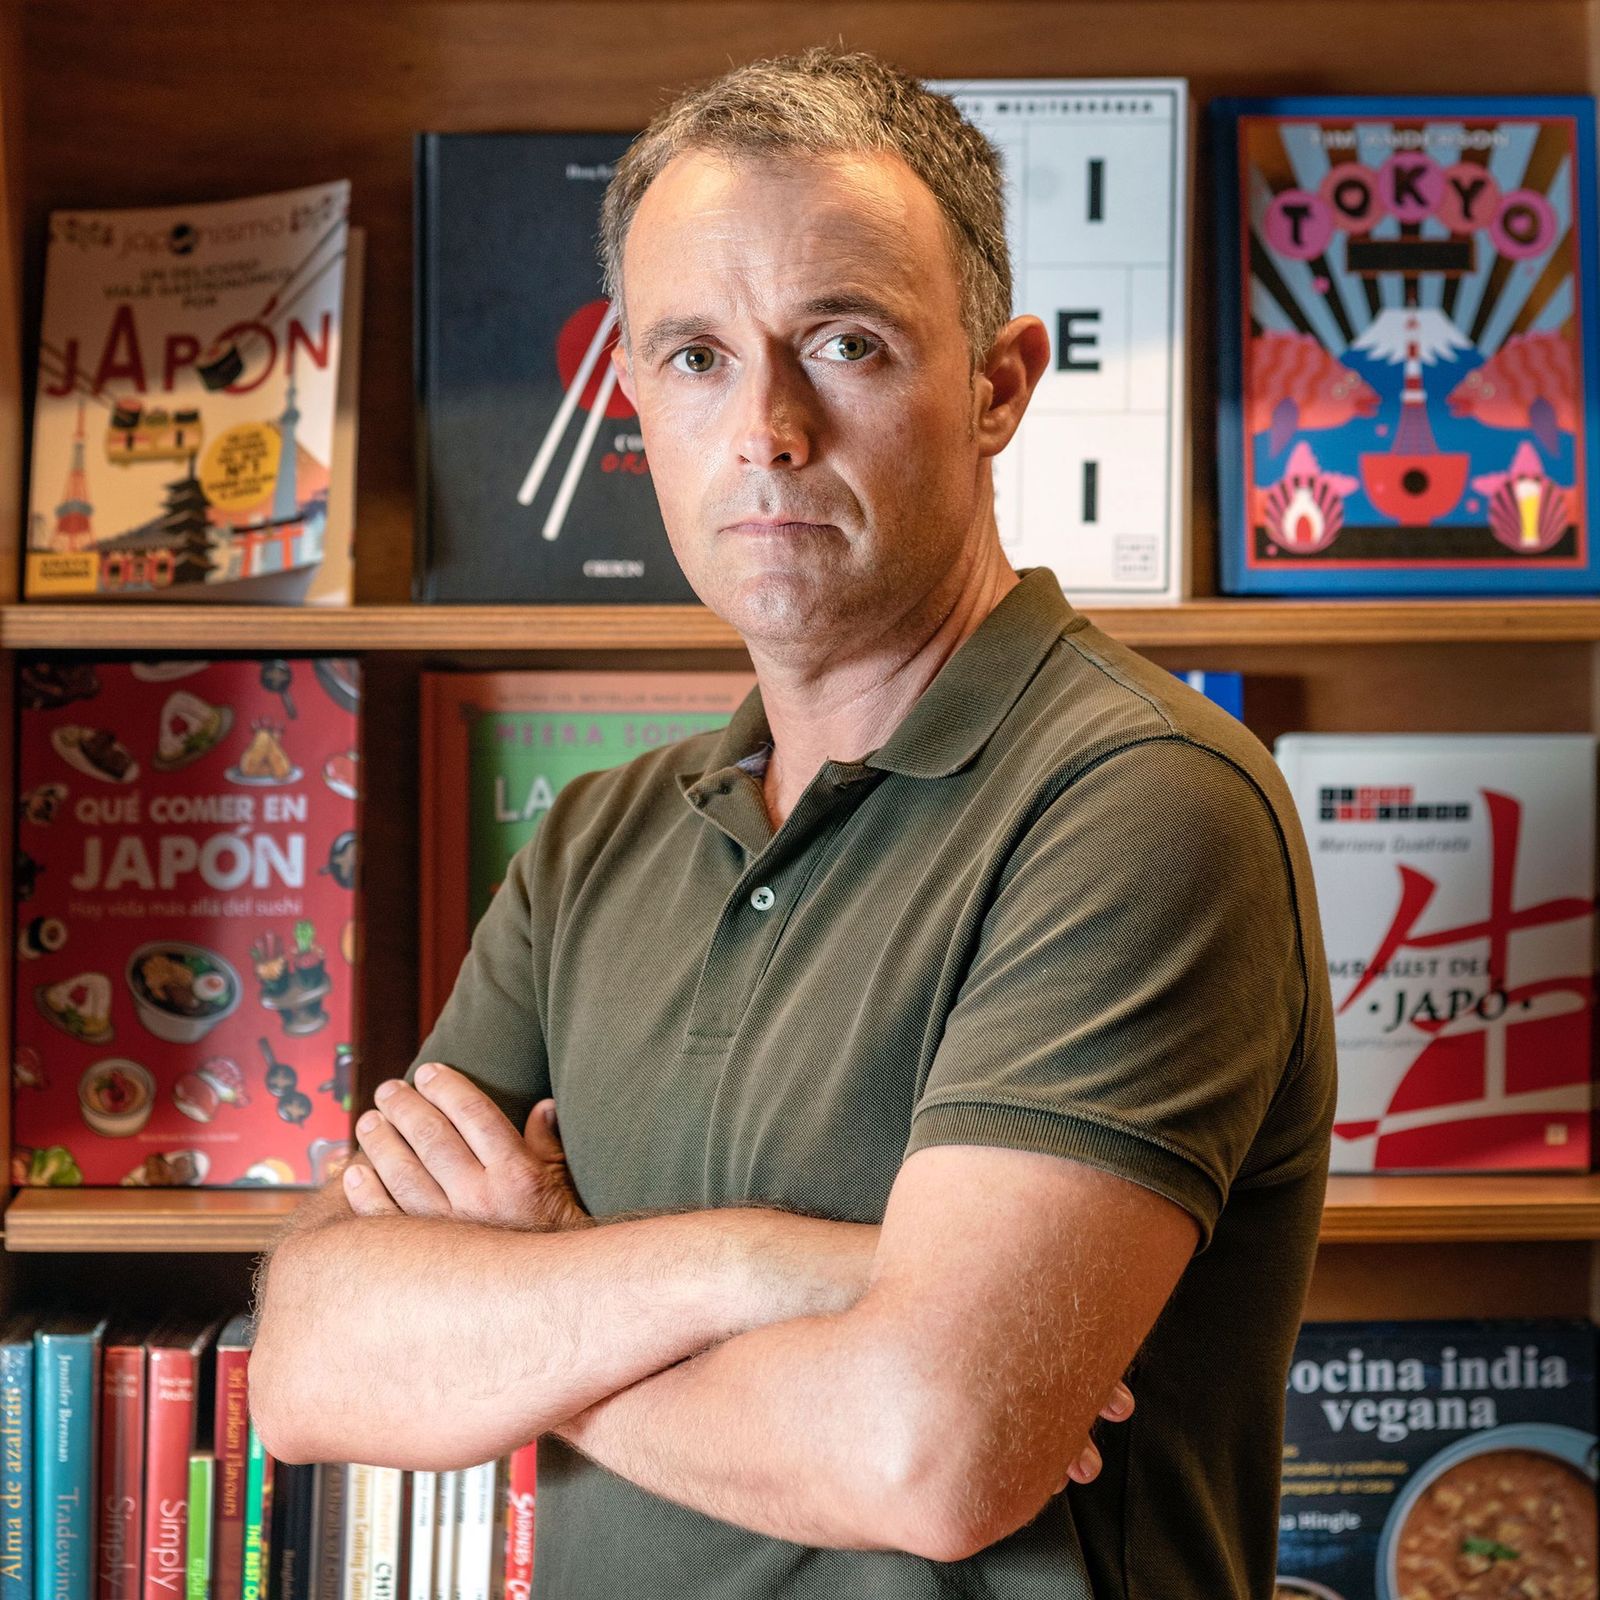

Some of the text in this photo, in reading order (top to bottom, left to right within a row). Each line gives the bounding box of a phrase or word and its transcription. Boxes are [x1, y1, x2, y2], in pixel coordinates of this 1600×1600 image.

[1281, 165, 1541, 246] TOKYO
[46, 297, 332, 397] JAPÓN
[496, 722, 603, 745] MEERA
[75, 793, 307, 823] QUÉ COMER EN
[71, 825, 306, 891] JAPÓN
[228, 1366, 246, 1389] Sri
[1285, 1346, 1570, 1394] ocina india
[57, 1355, 73, 1462] Jennifer Brennan
[226, 1392, 244, 1449] Lankan
[1321, 1396, 1499, 1443] vegana
[0, 1387, 23, 1582] Alma de azafrán
[100, 1496, 136, 1589] Simply
[149, 1499, 188, 1592] Simply
[245, 1525, 262, 1547] THE
